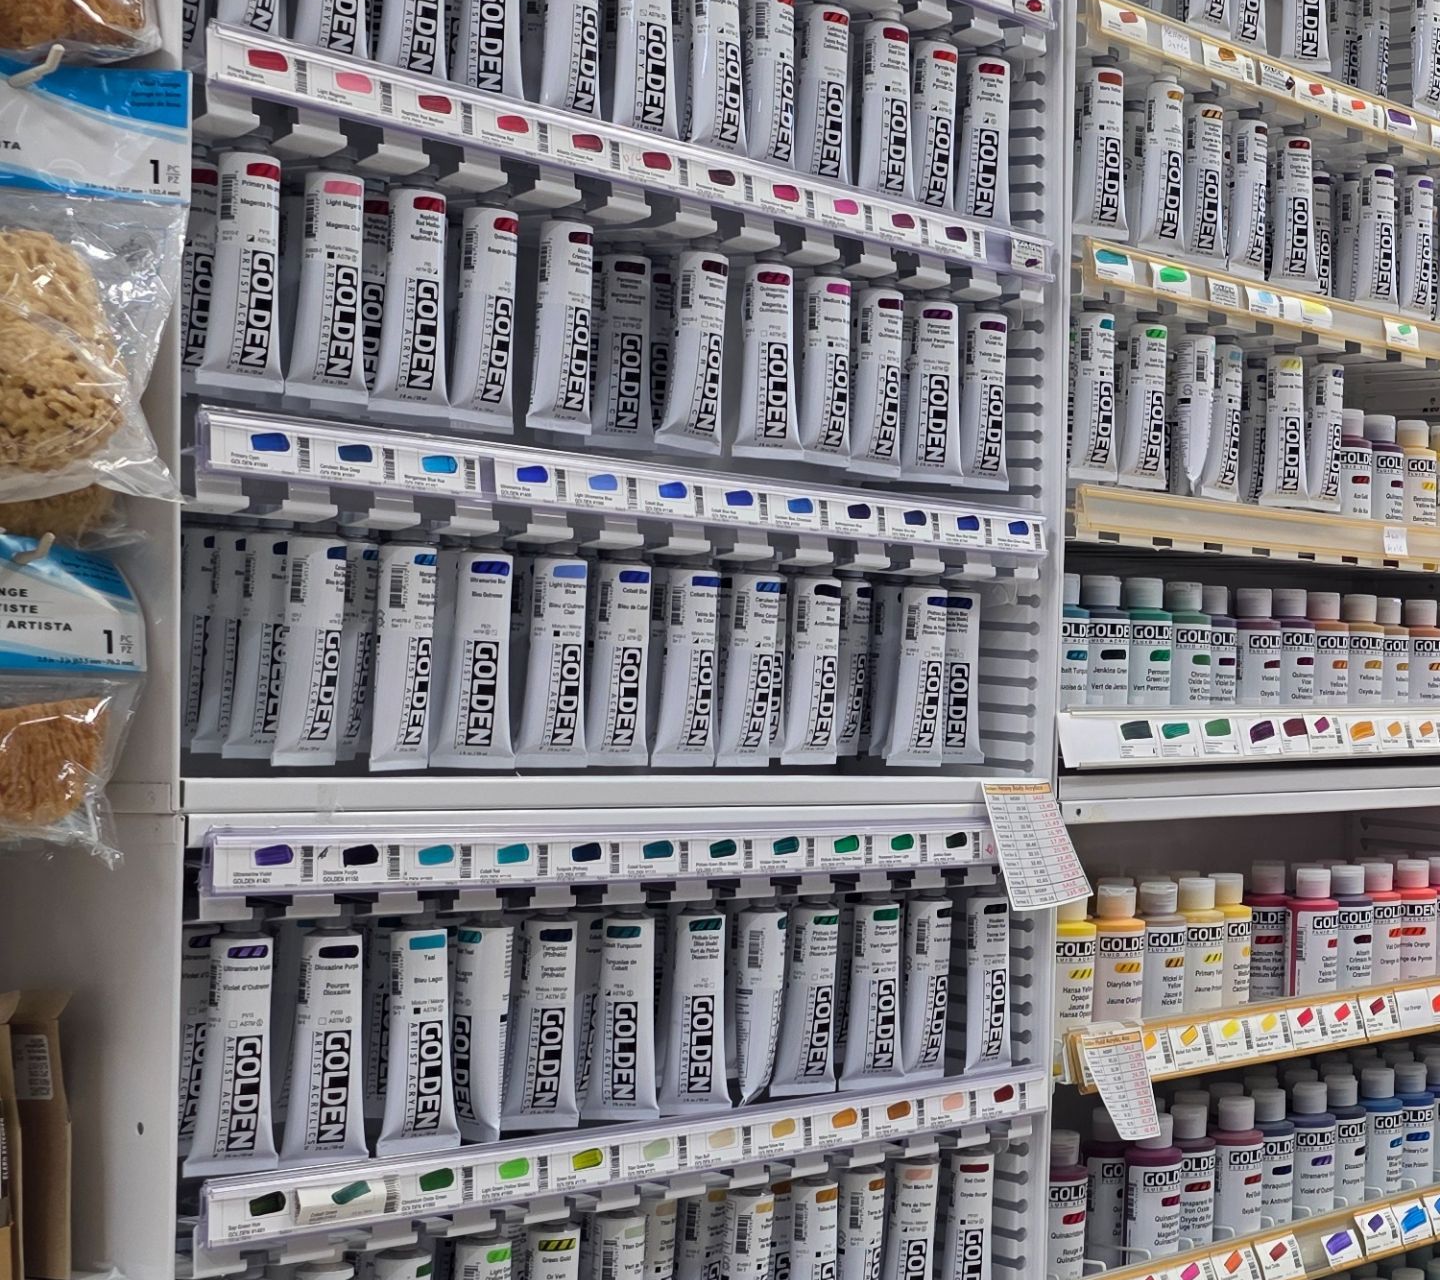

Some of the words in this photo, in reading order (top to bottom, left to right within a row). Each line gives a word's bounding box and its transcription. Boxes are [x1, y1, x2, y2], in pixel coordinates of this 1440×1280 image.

[640, 23, 667, 126] GOLDEN
[150, 159, 159, 184] 1
[885, 98, 908, 192] GOLDEN
[974, 128, 999, 218] GOLDEN
[1198, 167, 1221, 250] GOLDEN
[239, 251, 250, 295] ARTIST
[241, 251, 275, 369] GOLDEN
[405, 278, 416, 321] ARTIST
[408, 278, 440, 392] GOLDEN
[564, 307, 590, 413] GOLDEN
[764, 341, 790, 439] GOLDEN
[925, 374, 949, 464] GOLDEN
[1283, 415, 1302, 492] GOLDEN
[7, 620, 72, 631] ARTISTA
[103, 629, 113, 654] 1
[465, 641, 498, 746] GOLDEN
[612, 646, 641, 746] GOLDEN
[687, 650, 714, 746] GOLDEN
[946, 661, 970, 749] GOLDEN
[1100, 936, 1144, 953] GOLDE
[1400, 902, 1436, 917] OLDEN
[224, 1034, 236, 1077] ARTIST
[611, 1001, 638, 1101] GOLDEN
[691, 995, 714, 1094] GOLDEN
[874, 978, 896, 1069] GOLDEN
[226, 1034, 263, 1151] GOLDEN
[411, 1021, 442, 1132] GOLDEN
